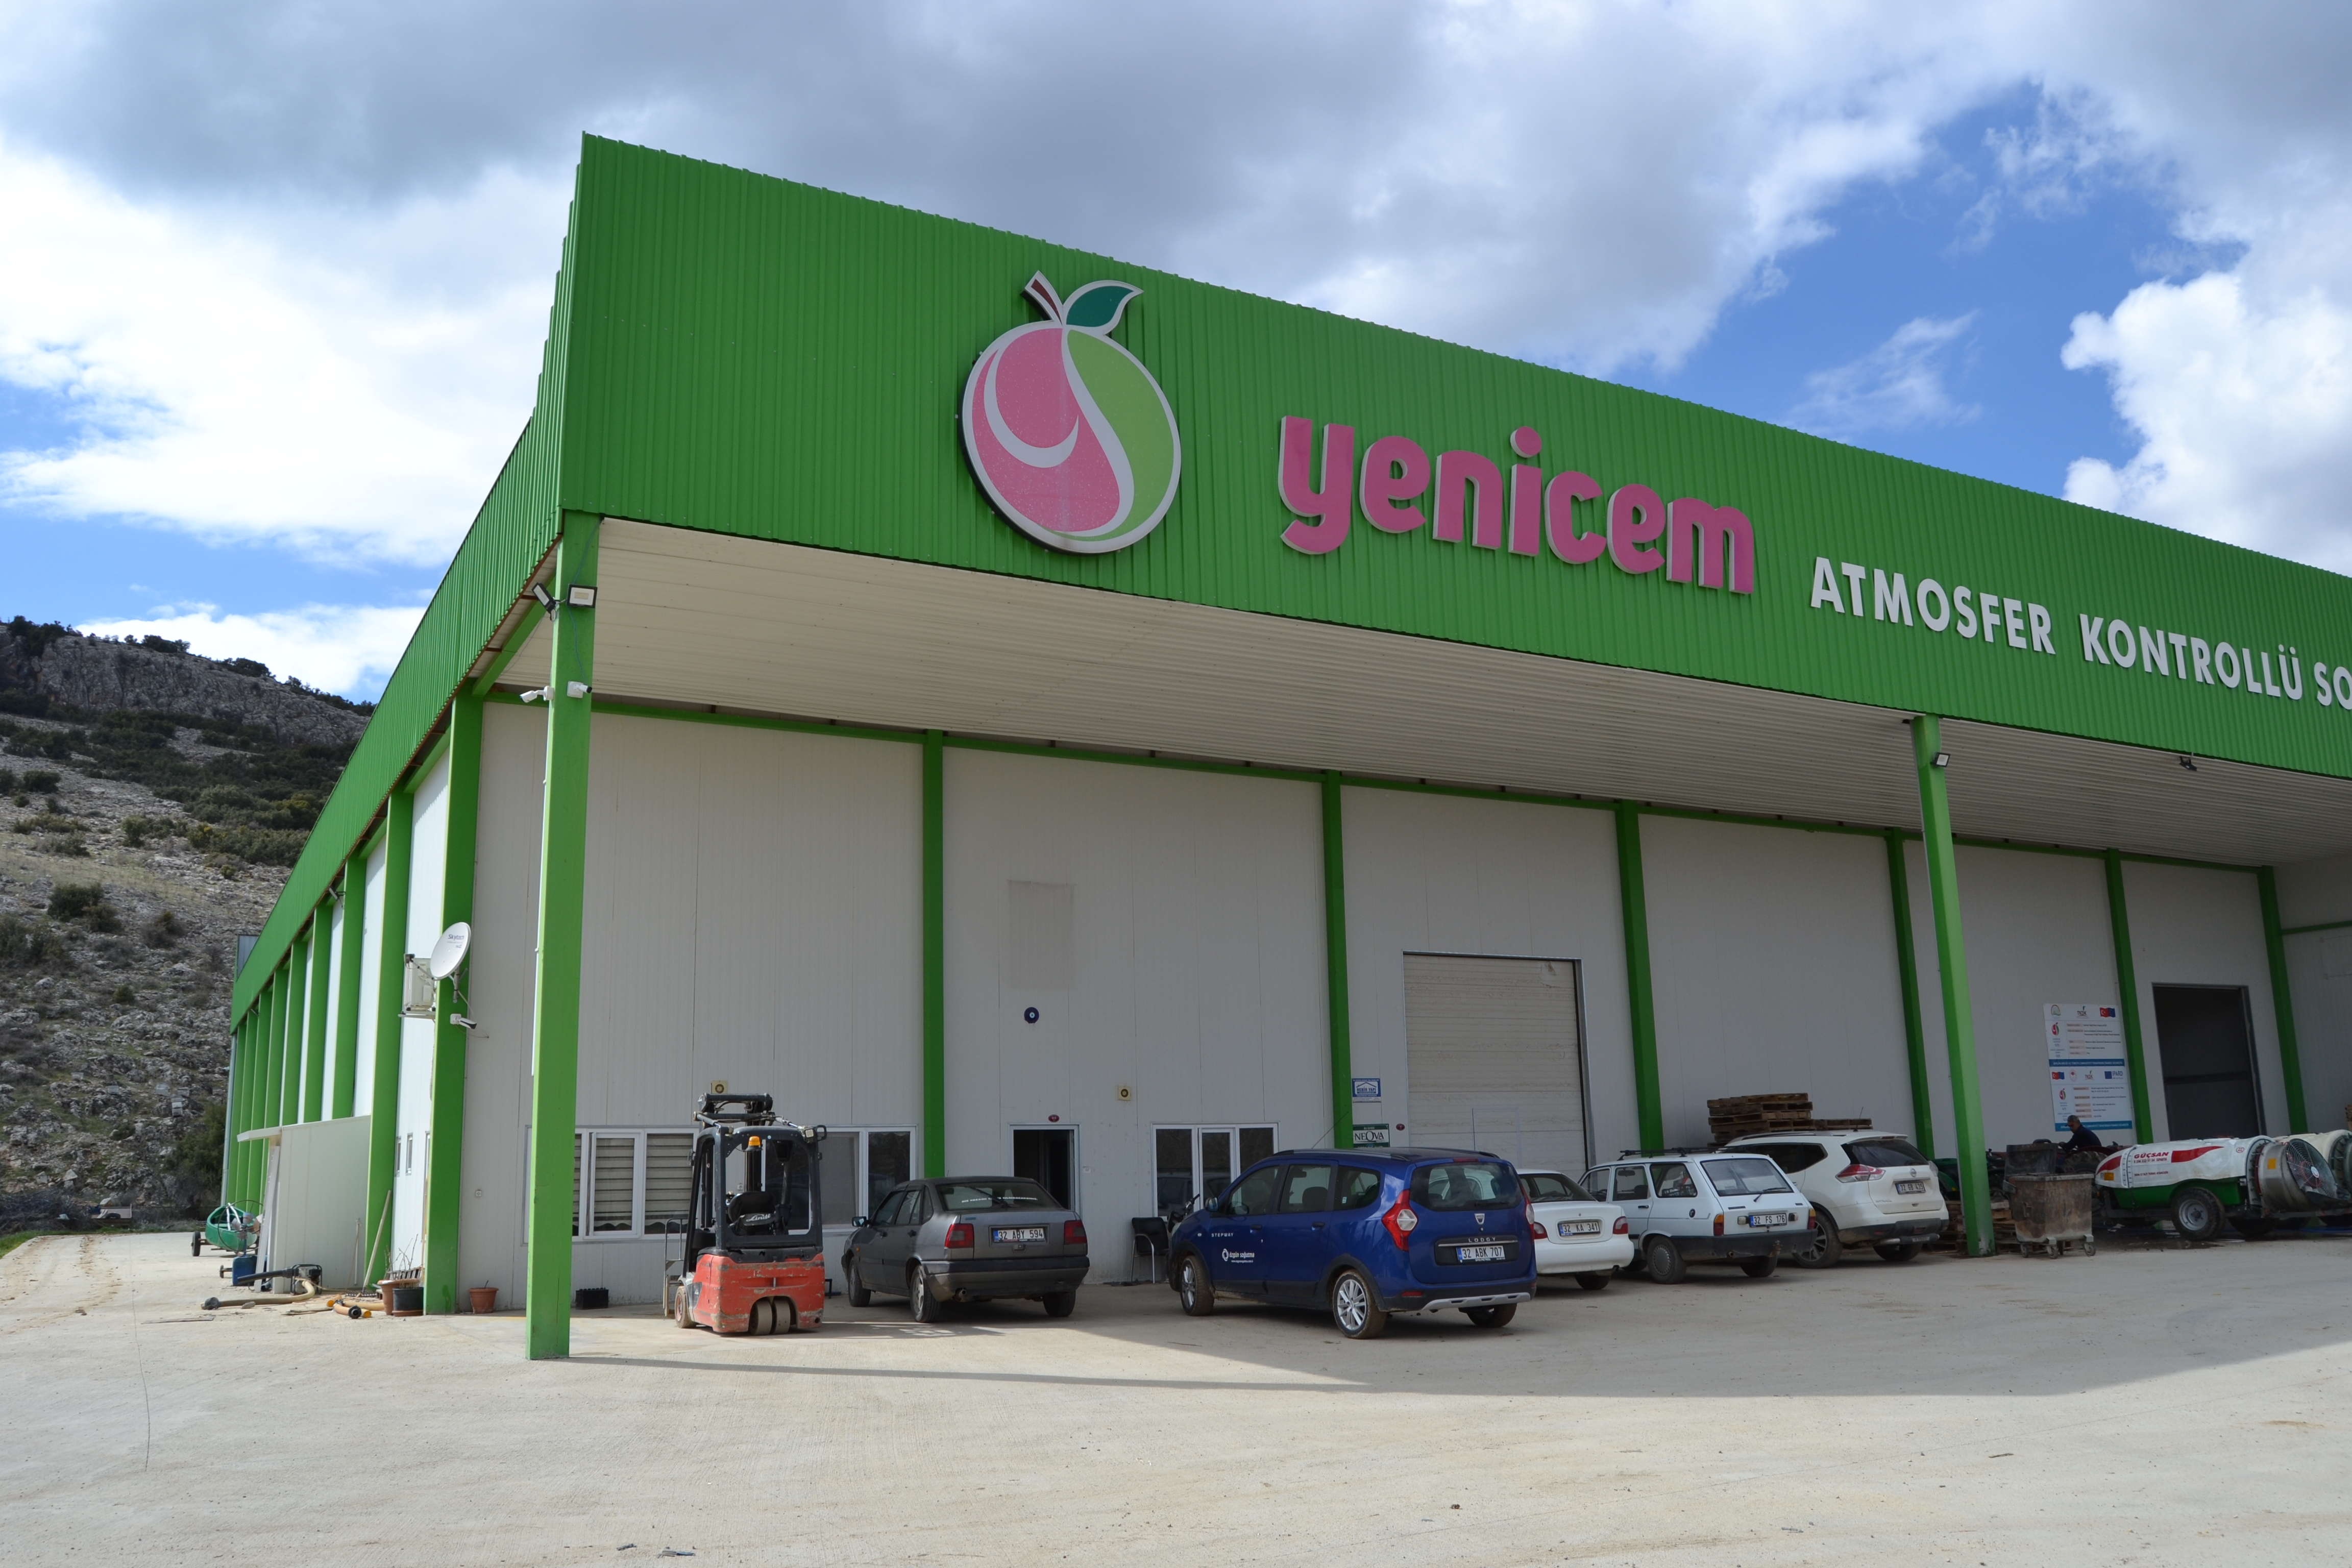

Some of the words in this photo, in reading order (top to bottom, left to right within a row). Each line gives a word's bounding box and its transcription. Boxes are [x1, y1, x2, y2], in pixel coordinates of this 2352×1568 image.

[1278, 415, 1754, 595] yenicem
[1810, 556, 2056, 655] ATMOSFER
[2080, 614, 2303, 700] KONTROLLÜ
[1355, 1131, 1384, 1141] NEOVA
[1753, 1216, 1761, 1224] 32
[1776, 1215, 1785, 1223] 176
[1587, 1223, 1598, 1231] 341
[999, 1231, 1008, 1240] 32
[1013, 1230, 1025, 1239] ABY
[1030, 1230, 1043, 1238] 594
[1462, 1248, 1472, 1258] 32
[1475, 1247, 1488, 1258] ABK
[1490, 1247, 1502, 1257] 707
